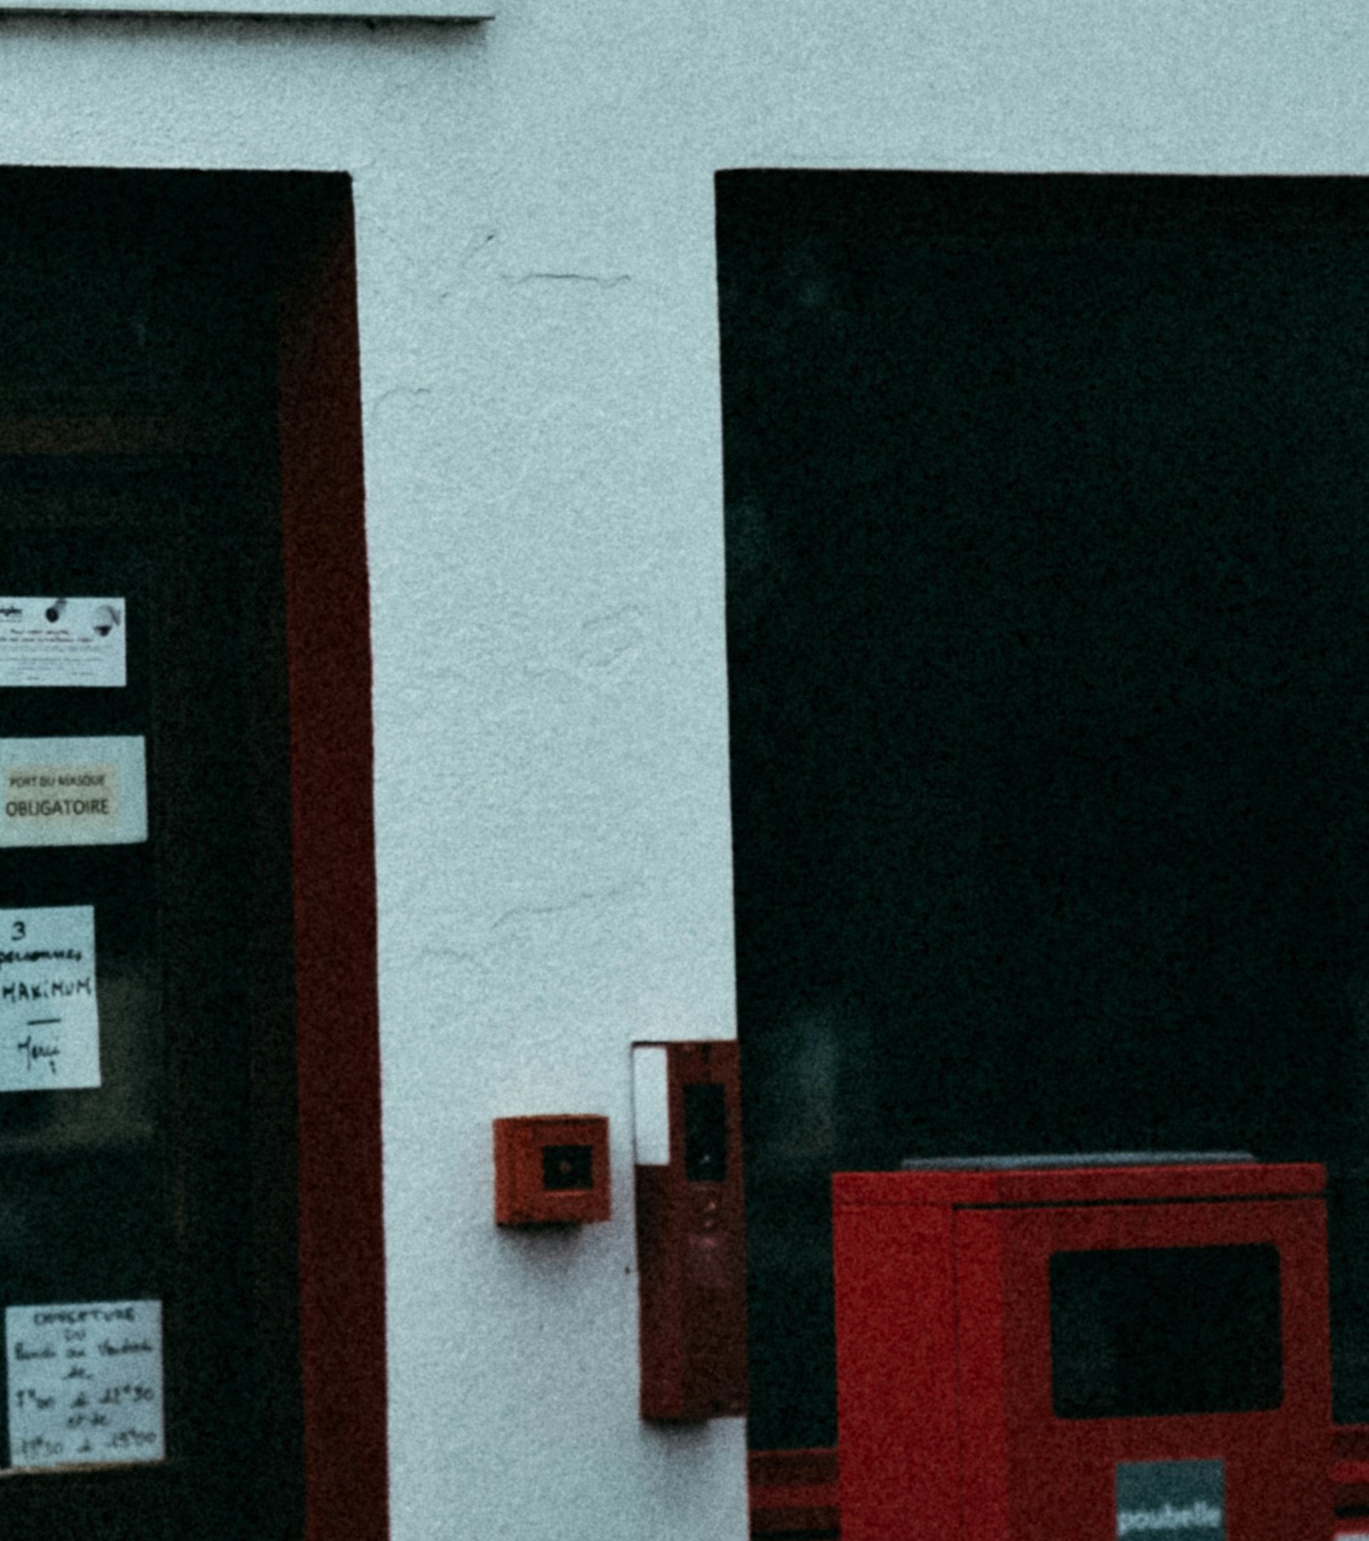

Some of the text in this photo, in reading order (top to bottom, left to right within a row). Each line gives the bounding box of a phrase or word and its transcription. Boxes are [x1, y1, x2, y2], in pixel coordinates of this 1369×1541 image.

[9, 774, 106, 788] PORT DU MASQUE
[6, 799, 110, 817] OBLIGATOIRE
[12, 920, 26, 941] 3
[33, 1308, 135, 1327] OUVERTURE
